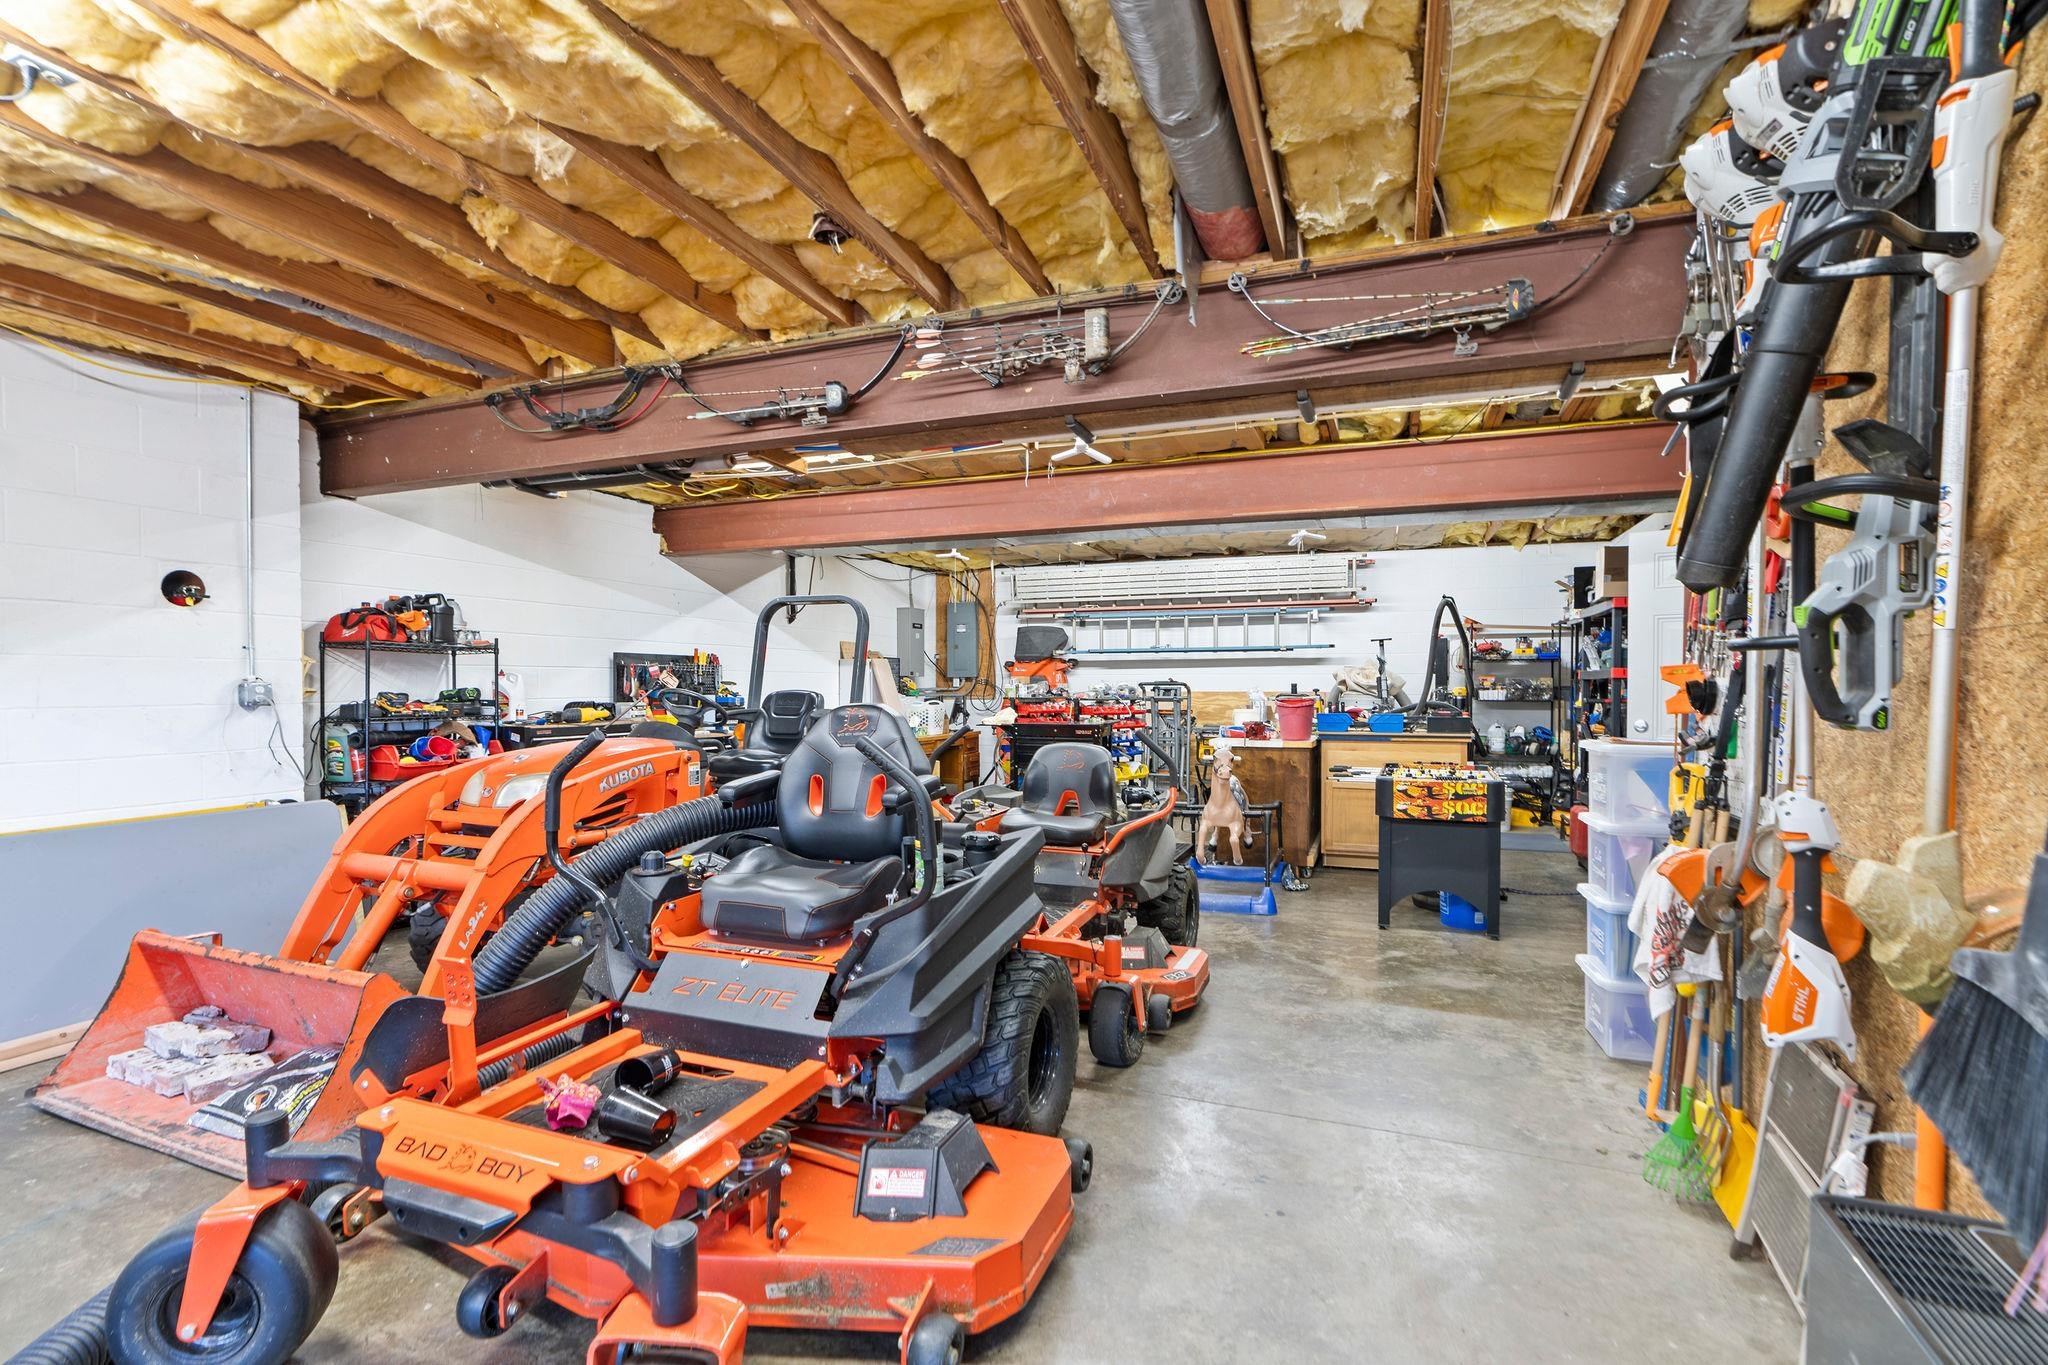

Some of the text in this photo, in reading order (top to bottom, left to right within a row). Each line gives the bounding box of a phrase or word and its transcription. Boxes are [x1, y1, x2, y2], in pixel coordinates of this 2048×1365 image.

[599, 762, 655, 793] KUBOTA
[672, 976, 798, 1010] ZT ELITE
[1792, 986, 1810, 1024] STIHL
[395, 1136, 535, 1183] BAD BOY
[899, 1169, 924, 1179] DANGER
